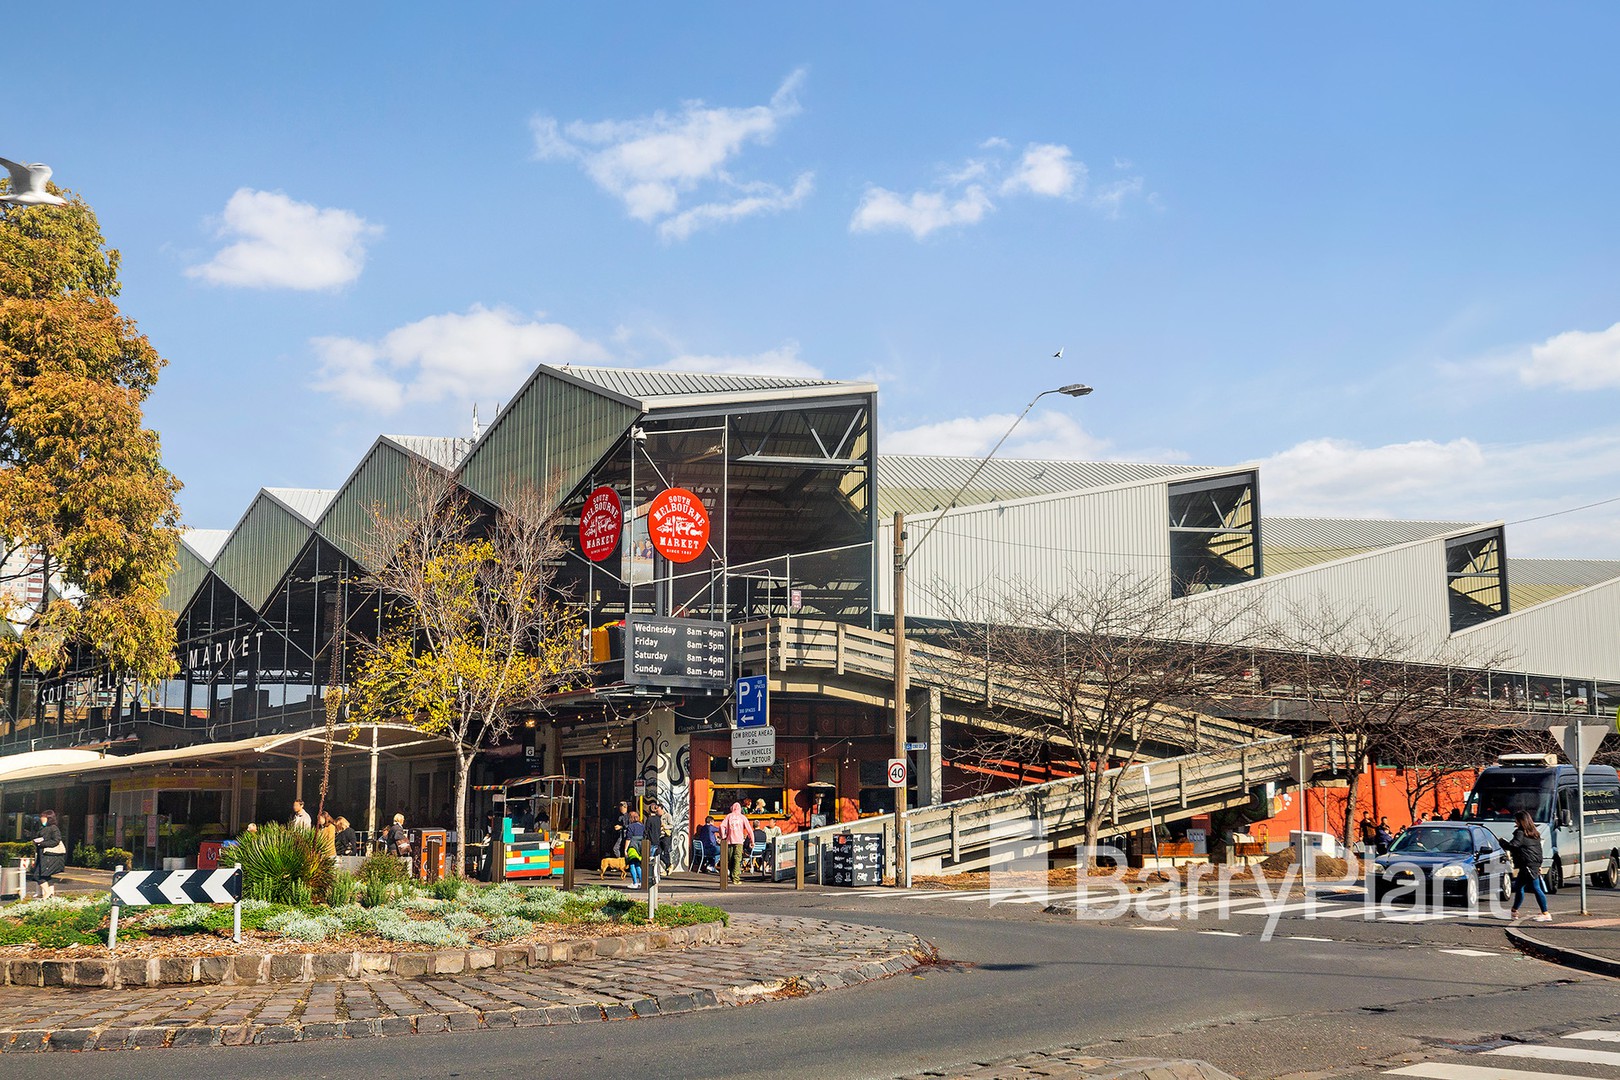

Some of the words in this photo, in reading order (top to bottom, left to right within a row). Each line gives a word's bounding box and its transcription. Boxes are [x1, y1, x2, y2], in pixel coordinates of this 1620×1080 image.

[593, 494, 609, 505] SOUTH
[668, 495, 691, 506] SOUTH
[583, 501, 619, 526] MELBOURNE
[653, 502, 706, 527] MELBOURNE
[586, 534, 615, 549] MARKET
[659, 536, 699, 550] MARKET
[634, 623, 677, 636] Wednesday
[686, 627, 702, 636] 8am
[708, 629, 724, 639] 4pm
[189, 632, 264, 669] MARKET
[634, 637, 659, 647] Friday
[686, 641, 702, 649] 8am
[708, 642, 724, 651] 5pm
[634, 650, 668, 662] Saturday
[686, 654, 702, 662] 8am
[708, 655, 724, 665] 4pm
[634, 664, 663, 675] Sunday
[686, 667, 702, 675] 8am
[708, 668, 724, 678] 4pm
[41, 680, 78, 706] SOUTH
[739, 681, 751, 705] P
[742, 730, 757, 739] BRIDGE
[758, 729, 773, 737] AHEAD
[751, 748, 772, 756] VEHICLES
[752, 755, 771, 763] DETOUR
[891, 767, 904, 779] 40
